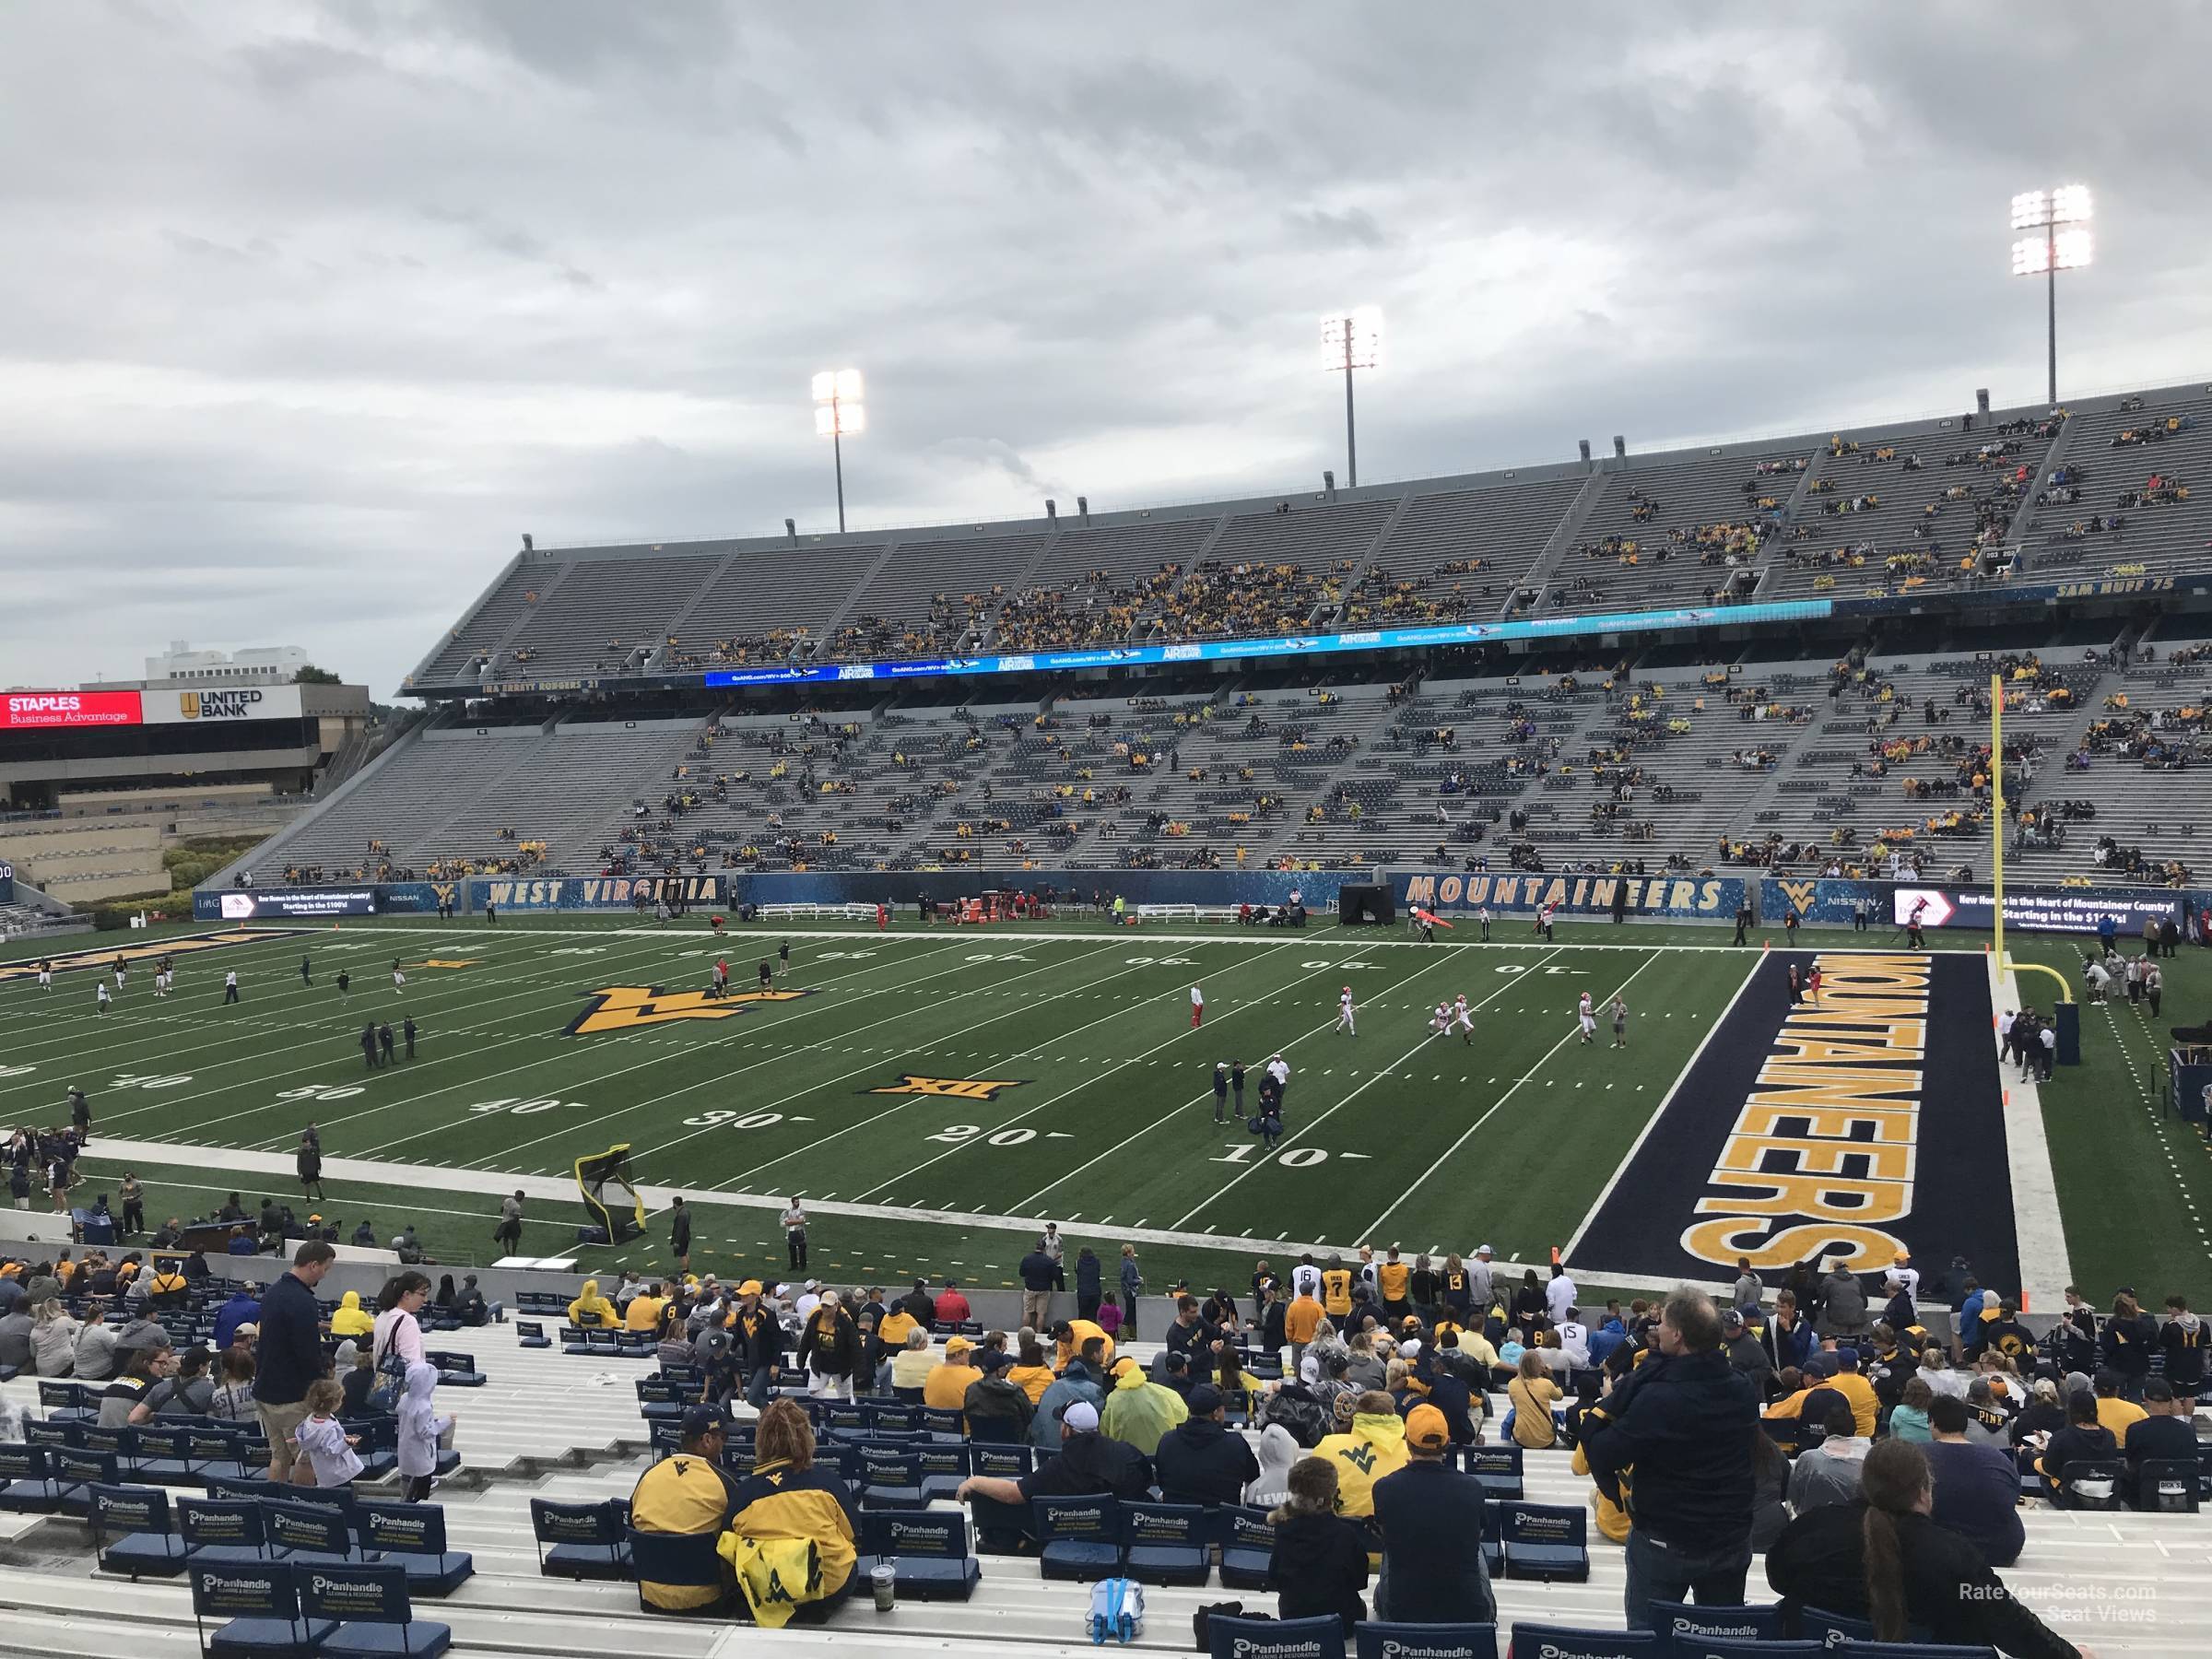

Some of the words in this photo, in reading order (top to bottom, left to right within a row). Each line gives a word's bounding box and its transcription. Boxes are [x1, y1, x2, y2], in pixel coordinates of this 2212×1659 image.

[2056, 583, 2093, 597] SAM
[2100, 580, 2146, 594] HUFF
[2151, 577, 2175, 591] 75
[1339, 634, 1356, 644] AIR
[1163, 648, 1180, 660] AIR
[891, 665, 937, 673] GoANG.com/WV
[998, 660, 1014, 671] AIR
[838, 669, 854, 679] AIR
[9, 696, 80, 712] STAPLES
[200, 690, 263, 705] UNITED
[201, 702, 248, 718] BANK
[10, 712, 62, 724] Business
[64, 712, 127, 724] Advantage
[489, 881, 562, 903] WEST
[1406, 876, 1721, 910] MOUNTAINEERS
[282, 902, 307, 911] Starting
[1959, 895, 1977, 905] New
[1979, 896, 2007, 906] Homs
[2009, 897, 2018, 905] in
[2018, 897, 2034, 906] the
[2036, 898, 2061, 908] Heart
[2062, 899, 2072, 908] of
[2074, 900, 2133, 911] Mountaineer
[2134, 900, 2175, 913] Country!
[2002, 910, 2048, 923] Starting
[2051, 911, 2061, 921] in
[2063, 911, 2083, 922] the
[109, 1075, 194, 1088] 40
[276, 1084, 366, 1100] 50
[468, 1098, 560, 1114] 40
[681, 1110, 783, 1129] 30
[1680, 955, 1933, 1274] MOUNTAINEERS
[924, 1124, 1038, 1147] 20
[1208, 1144, 1329, 1167] 10
[1300, 1269, 1312, 1282] 16
[1332, 1281, 1342, 1297] 7
[1449, 1275, 1463, 1290] 13
[667, 1306, 677, 1319] 8
[1534, 1330, 1544, 1346] 8
[1563, 1326, 1577, 1339] 15
[1978, 1410, 2003, 1426] PINK
[988, 1453, 1020, 1462] Panhandle
[874, 1465, 908, 1473] Panhandle
[2160, 1481, 2181, 1489] DICK'S
[225, 1488, 264, 1500] Panhandle
[108, 1499, 149, 1511] Panhandle
[198, 1513, 243, 1522] Panhandle
[554, 1514, 596, 1524] Panhandle
[1059, 1508, 1100, 1517] Panhandle
[286, 1518, 327, 1531] Panhandle
[381, 1516, 425, 1527] Panhandle
[1144, 1515, 1189, 1526] Panhandle
[1526, 1515, 1571, 1525] Panhandle
[902, 1525, 948, 1535] Panhandle
[217, 1578, 271, 1589] Panhandle
[326, 1580, 382, 1592] Panhandle
[1690, 1623, 1759, 1637] Panhandle
[1251, 1641, 1321, 1653] Panhandle
[1401, 1645, 1473, 1657] Panhandle
